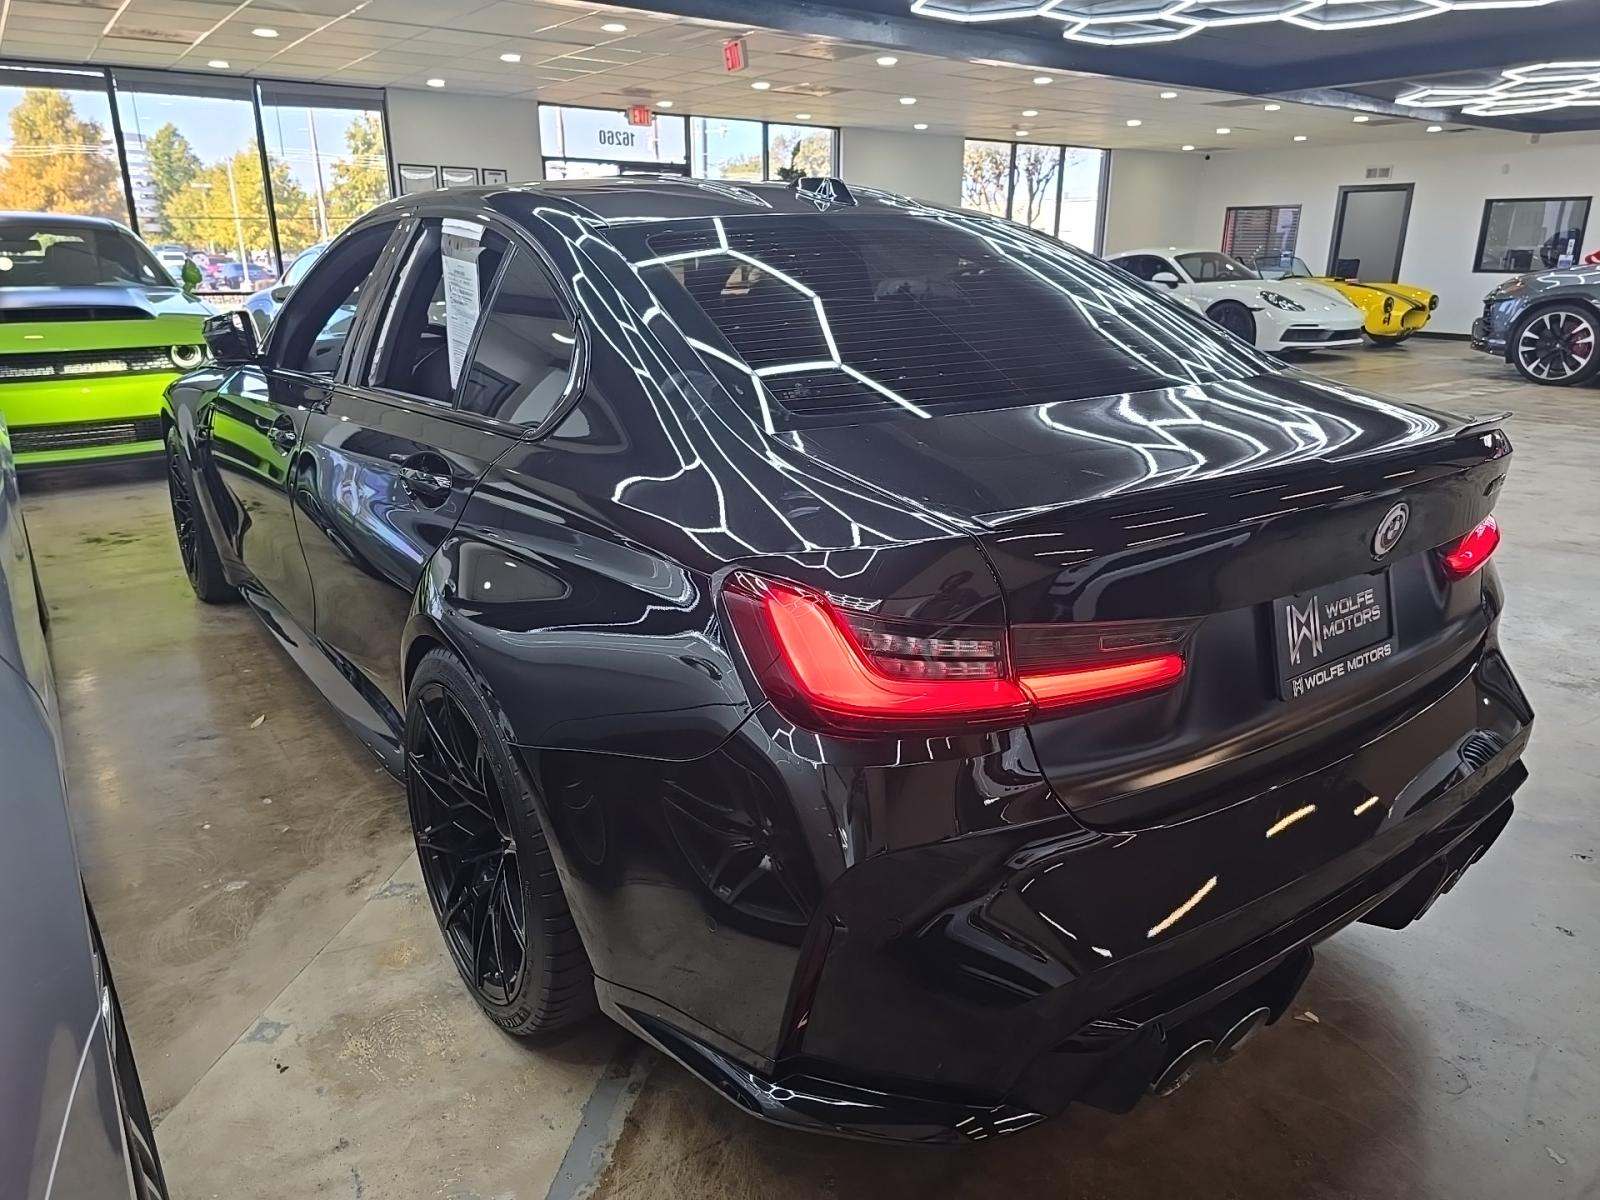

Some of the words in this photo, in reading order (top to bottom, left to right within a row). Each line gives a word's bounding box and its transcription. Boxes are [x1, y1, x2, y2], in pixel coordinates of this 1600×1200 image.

[1324, 588, 1375, 619] WOLFE
[1322, 605, 1381, 640] MOTORS
[1304, 662, 1345, 690] WOLFE
[1346, 643, 1392, 672] MOTORS
